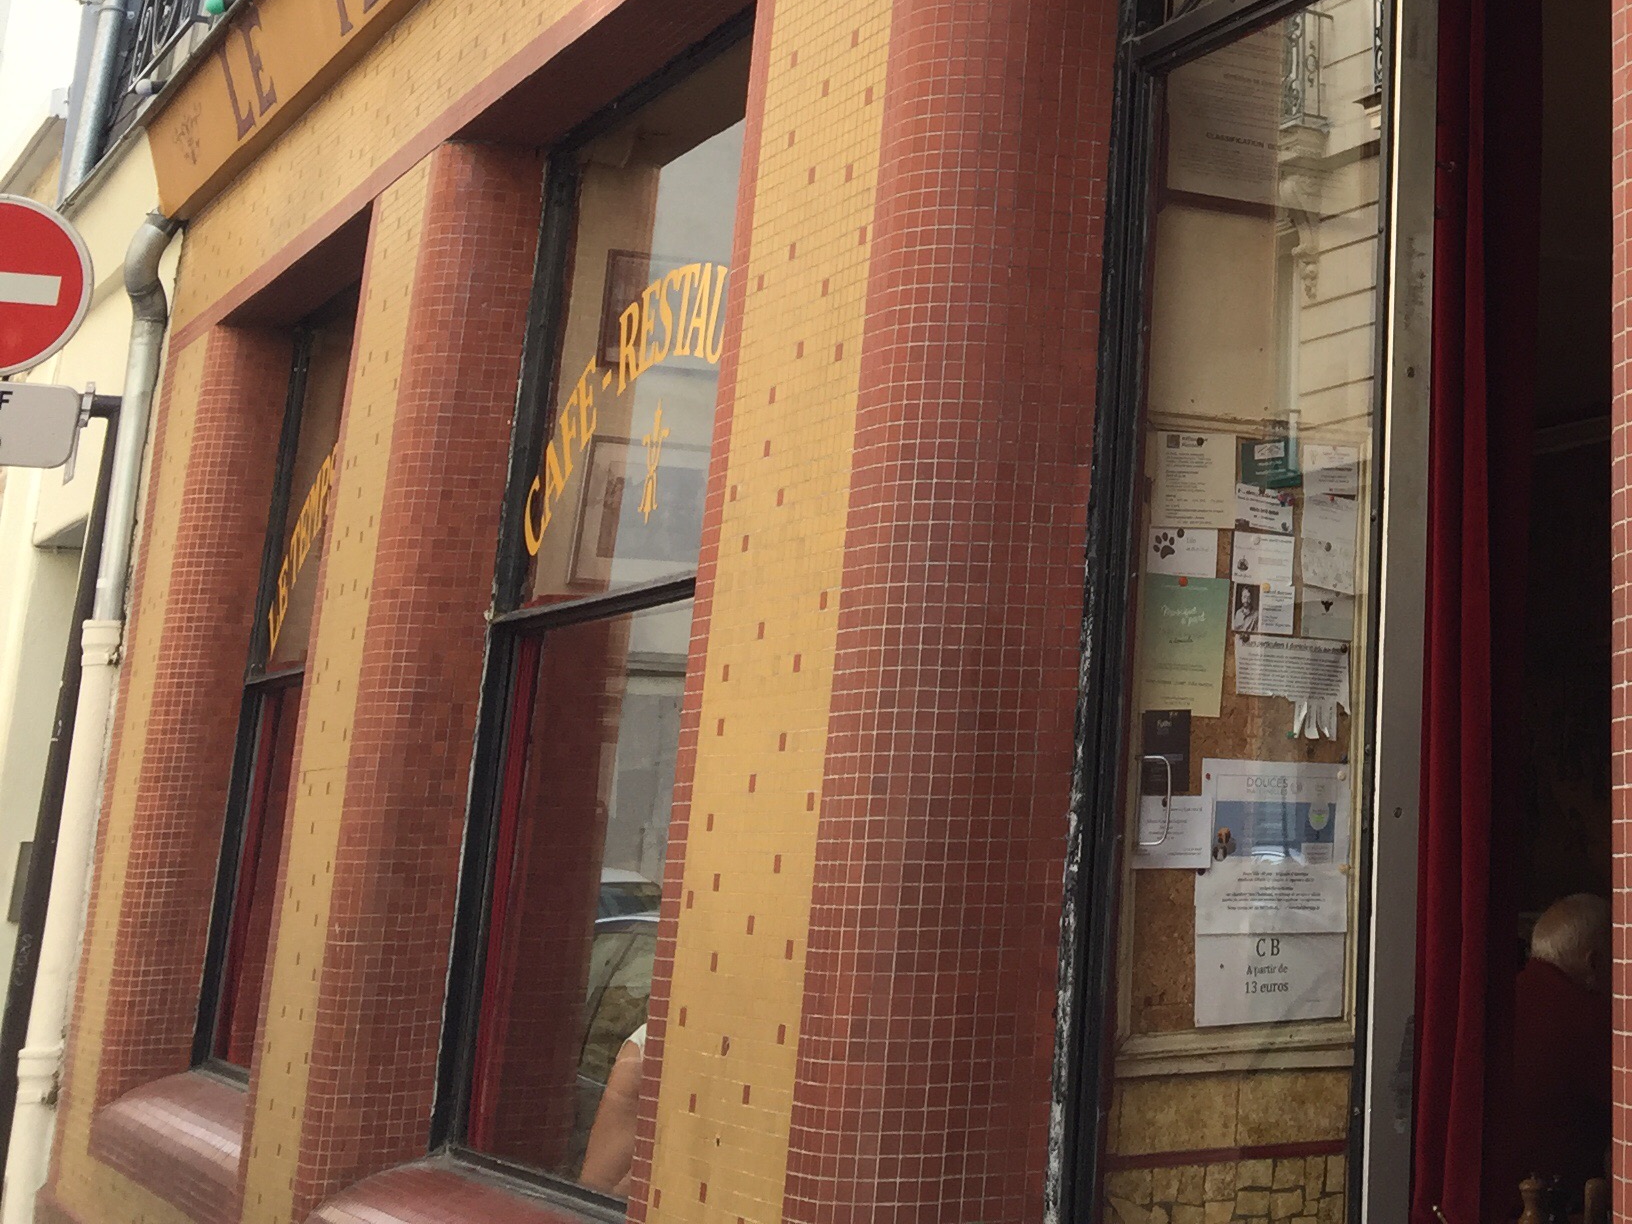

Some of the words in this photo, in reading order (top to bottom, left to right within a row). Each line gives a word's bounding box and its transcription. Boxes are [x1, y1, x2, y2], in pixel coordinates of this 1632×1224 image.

[217, 7, 277, 141] LE
[1278, 963, 1288, 974] de
[1245, 981, 1257, 994] 13
[1260, 982, 1288, 993] euros
